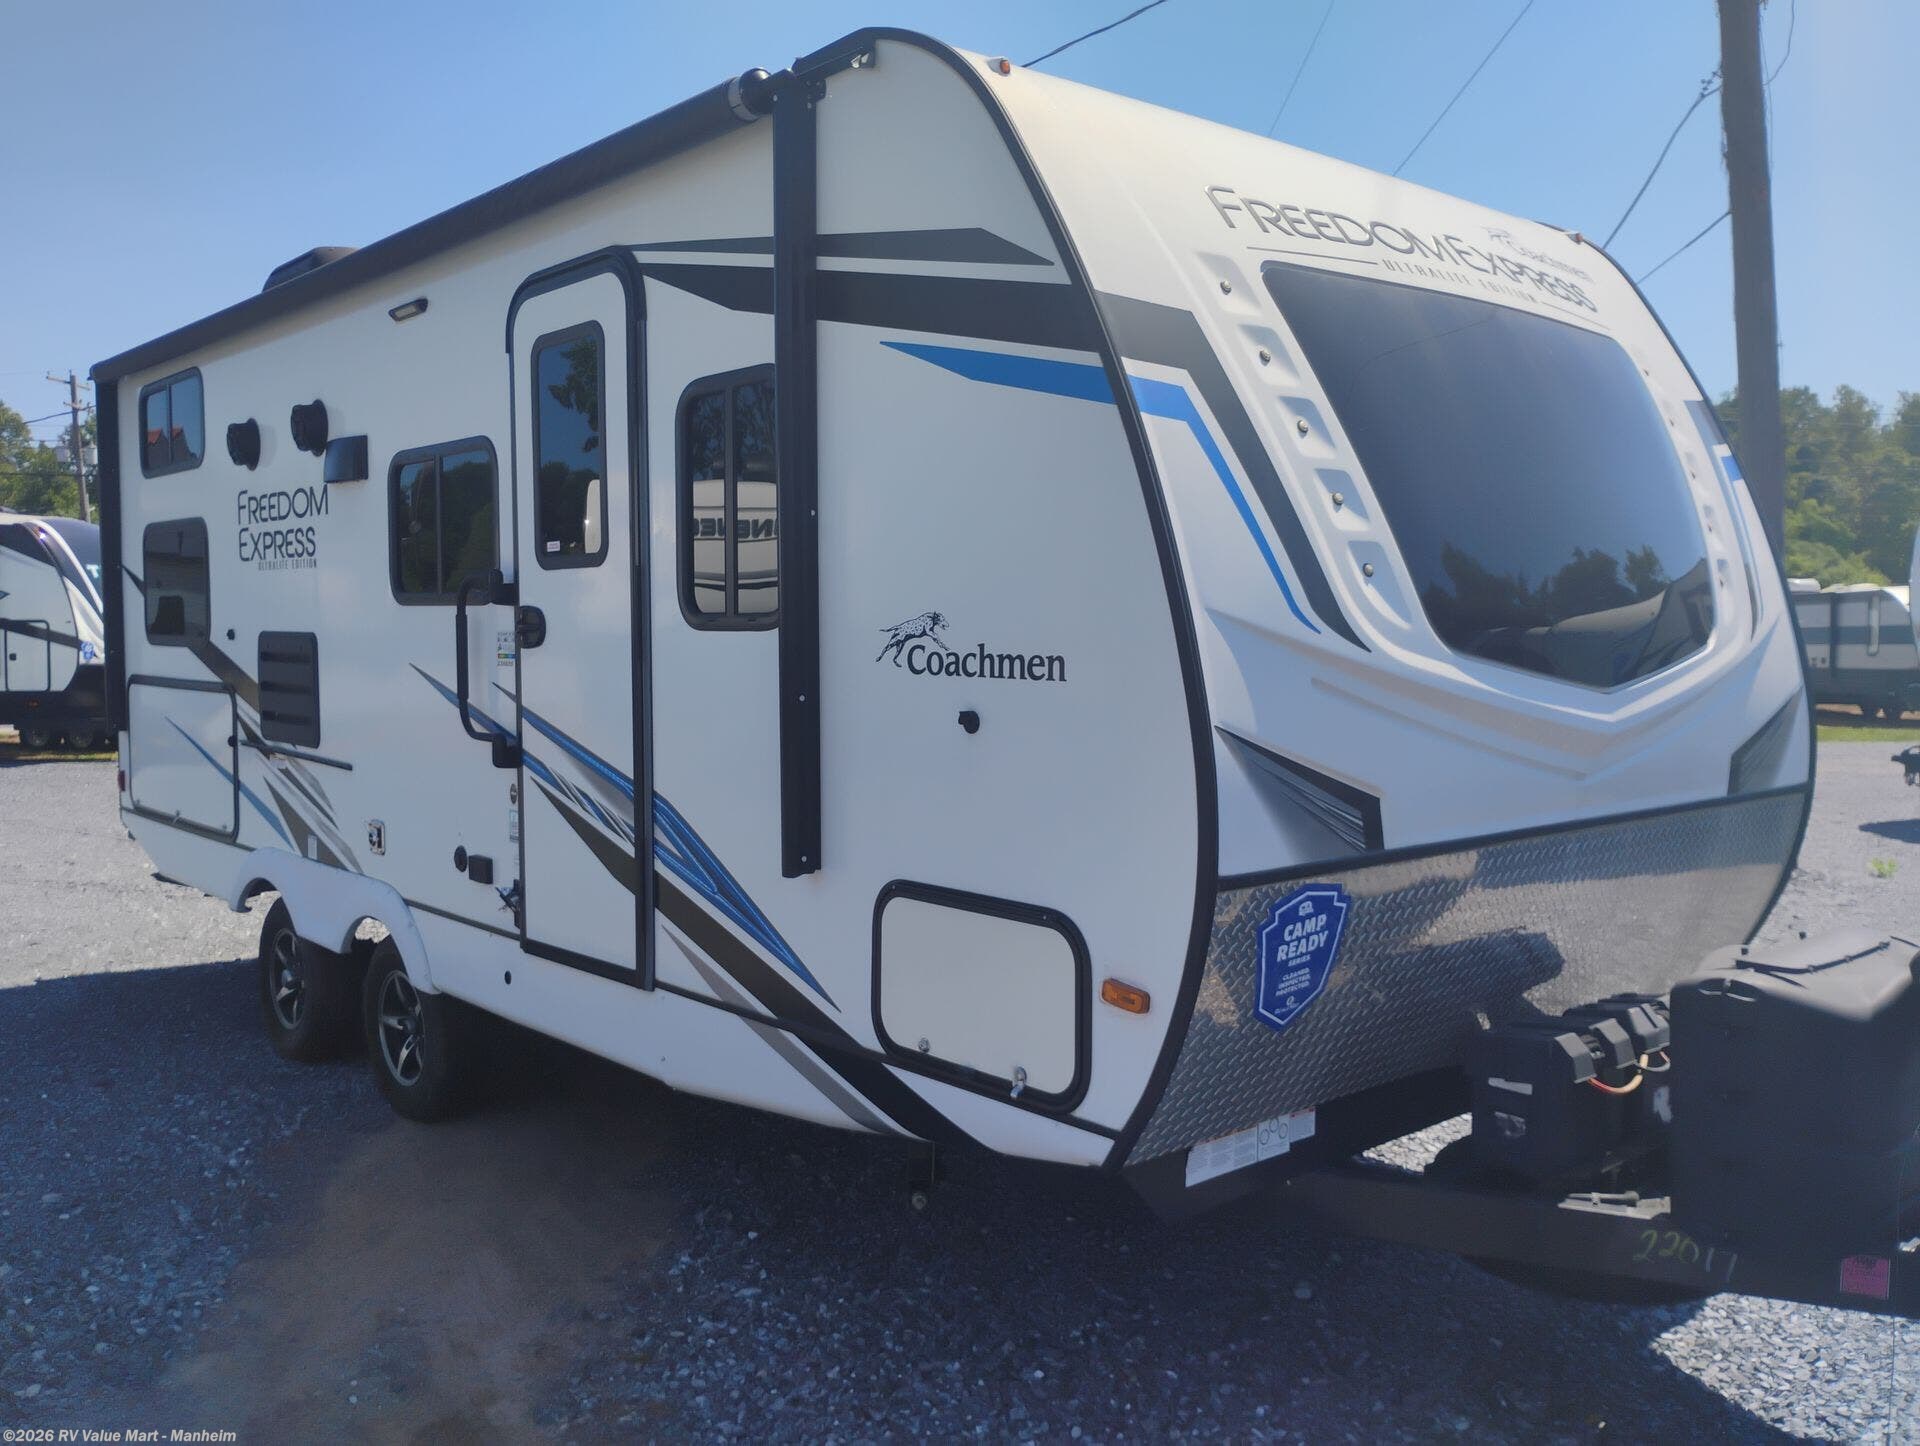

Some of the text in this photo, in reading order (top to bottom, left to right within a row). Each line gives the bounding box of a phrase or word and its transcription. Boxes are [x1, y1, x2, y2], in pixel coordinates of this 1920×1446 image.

[237, 483, 329, 525] FREEDOM
[238, 526, 316, 562] EXPRESS
[906, 642, 1067, 682] Coachmen
[1283, 913, 1328, 942] CAMP
[1276, 930, 1329, 962] READY
